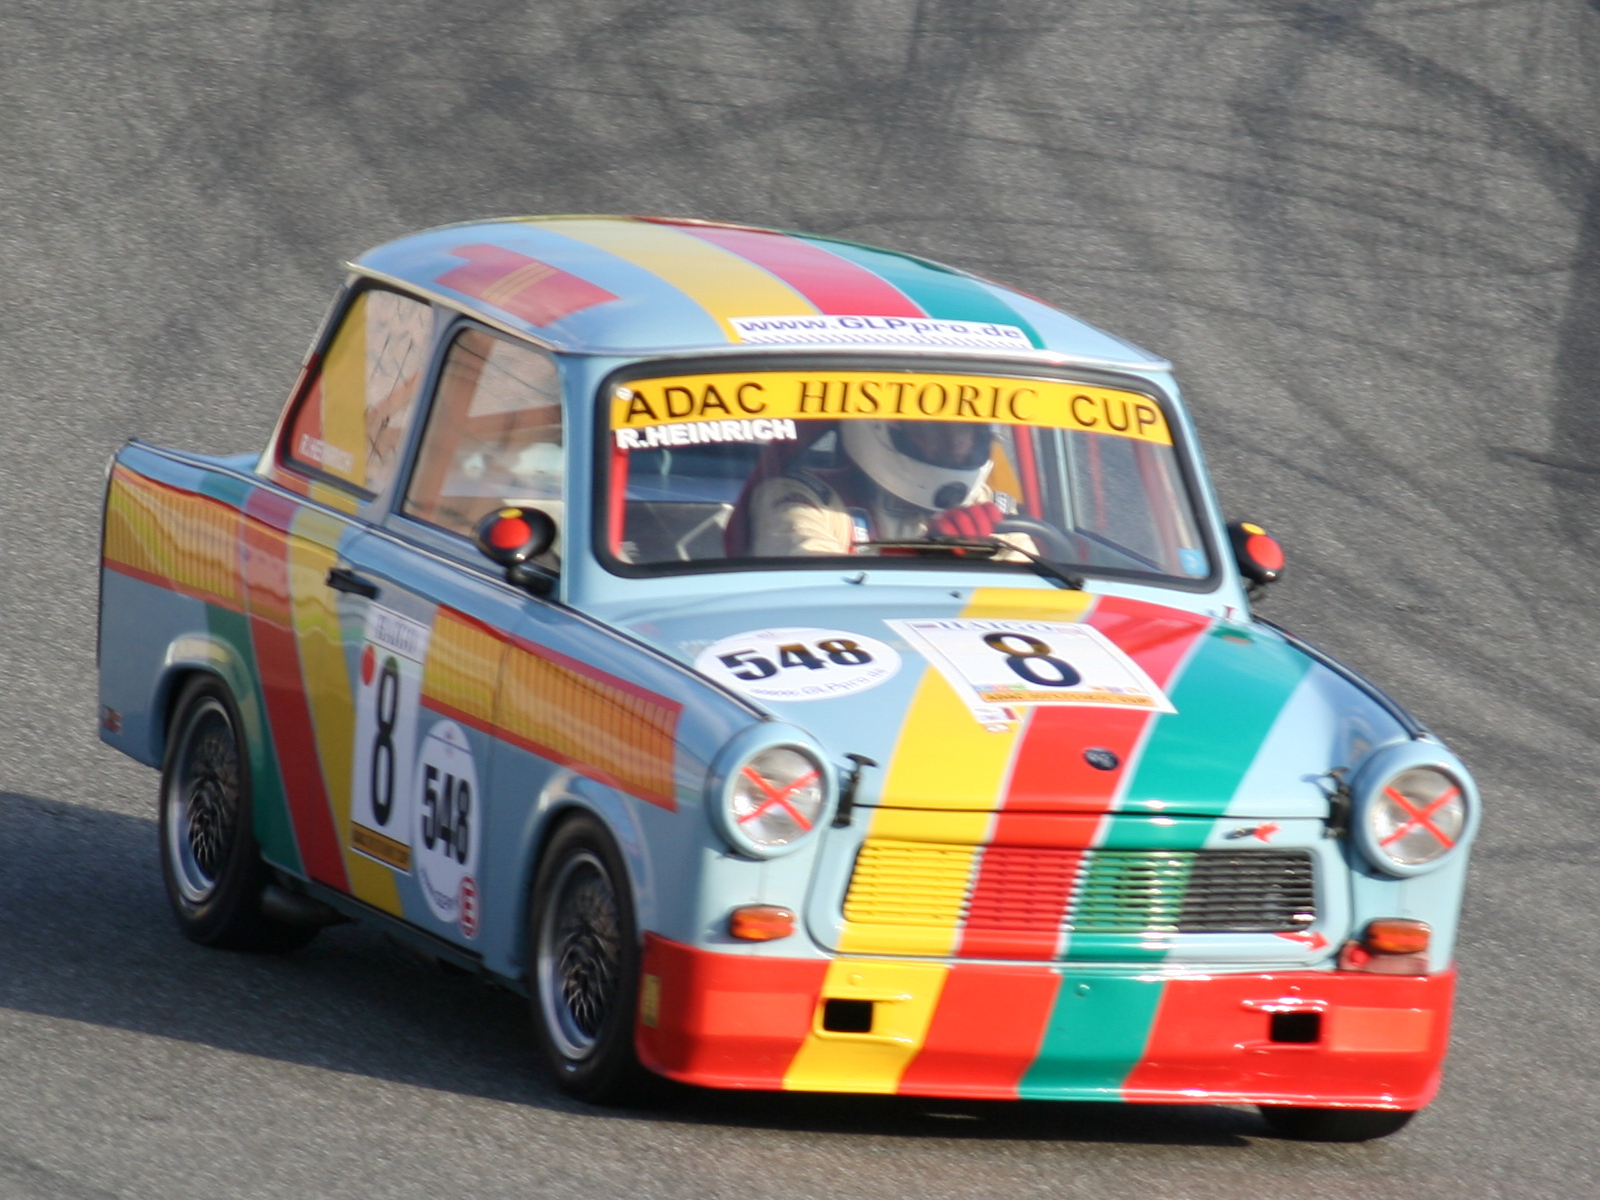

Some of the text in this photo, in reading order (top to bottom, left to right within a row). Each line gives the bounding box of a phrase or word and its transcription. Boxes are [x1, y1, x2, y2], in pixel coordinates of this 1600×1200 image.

[738, 316, 1022, 339] www.GLPpro.de
[615, 418, 797, 450] R.HEINRICH
[623, 380, 1157, 434] ADAC HISTORIC CUP
[715, 638, 874, 681] 548
[981, 632, 1081, 687] 8
[370, 656, 399, 827] 8
[420, 763, 473, 866] 548
